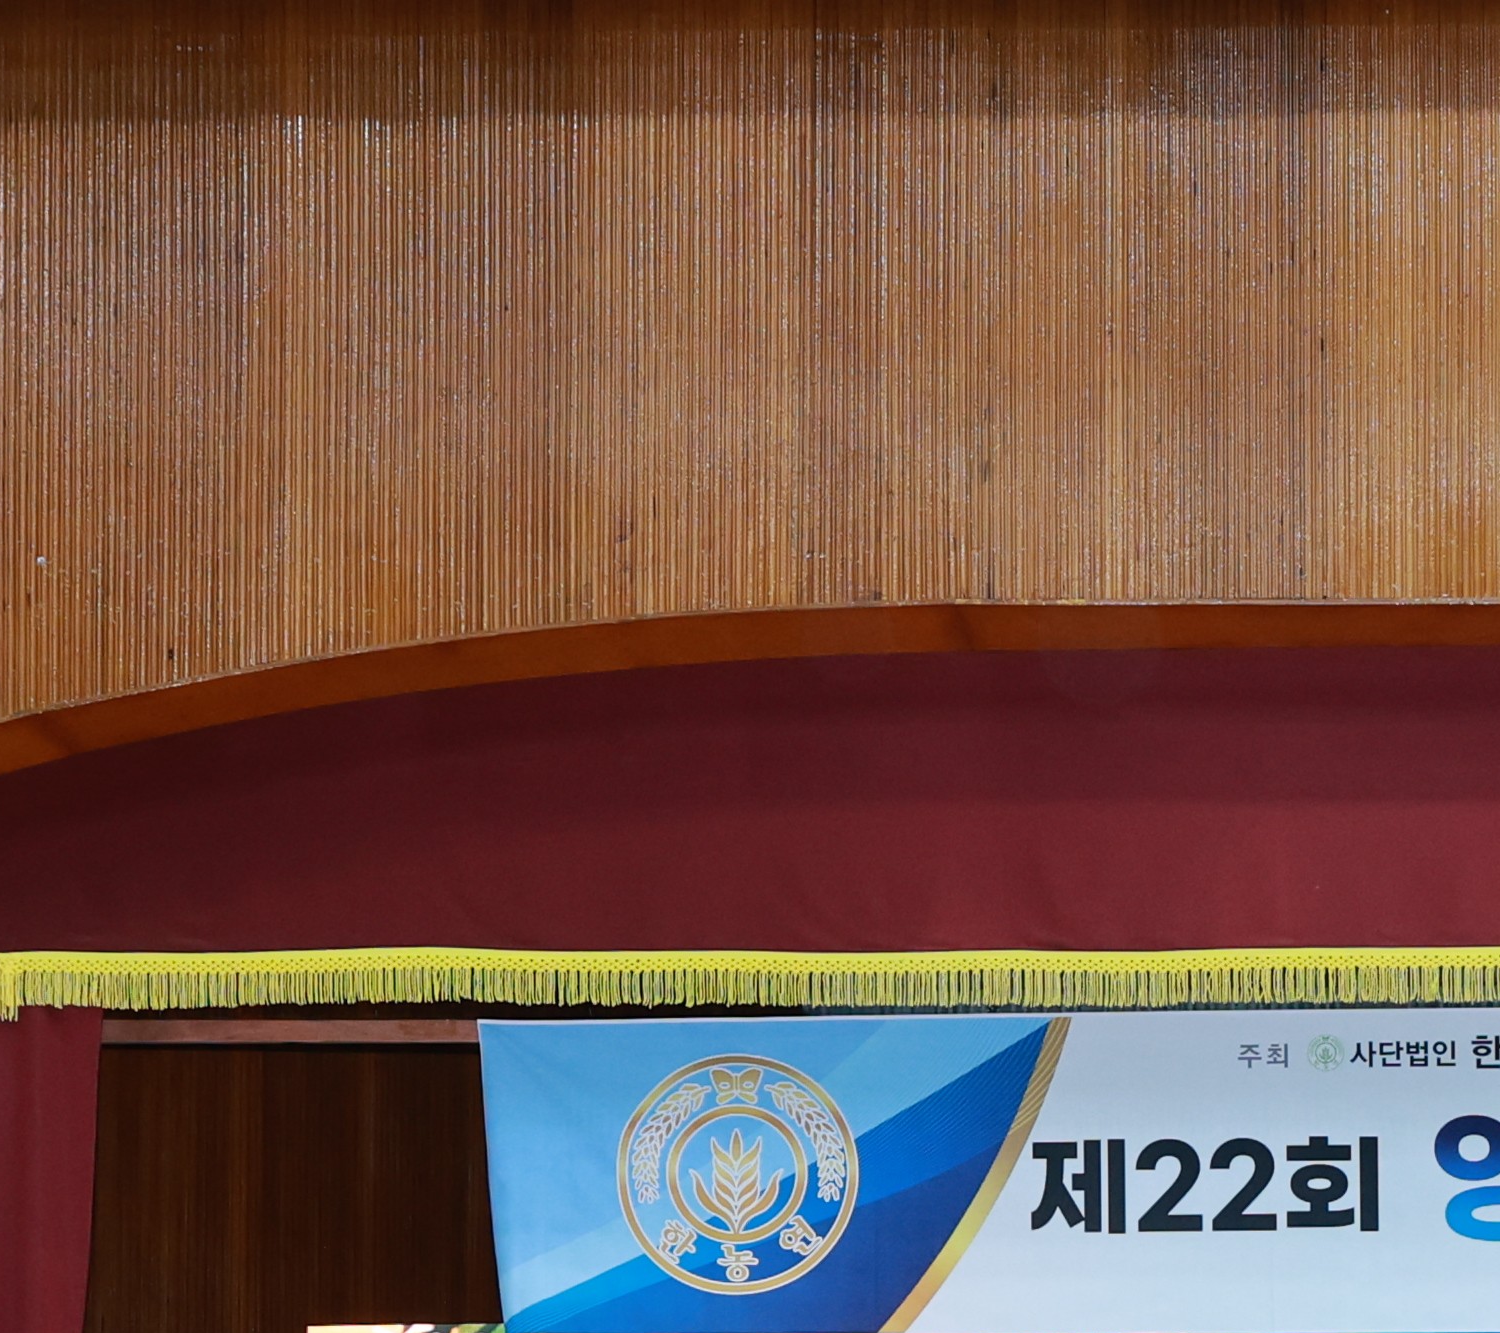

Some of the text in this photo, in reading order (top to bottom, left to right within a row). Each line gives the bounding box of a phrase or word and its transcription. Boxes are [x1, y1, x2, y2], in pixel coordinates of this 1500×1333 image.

[1237, 1042, 1291, 1069] 주최
[1349, 1039, 1459, 1068] 사단법인
[1030, 1135, 1380, 1234] 제22회
